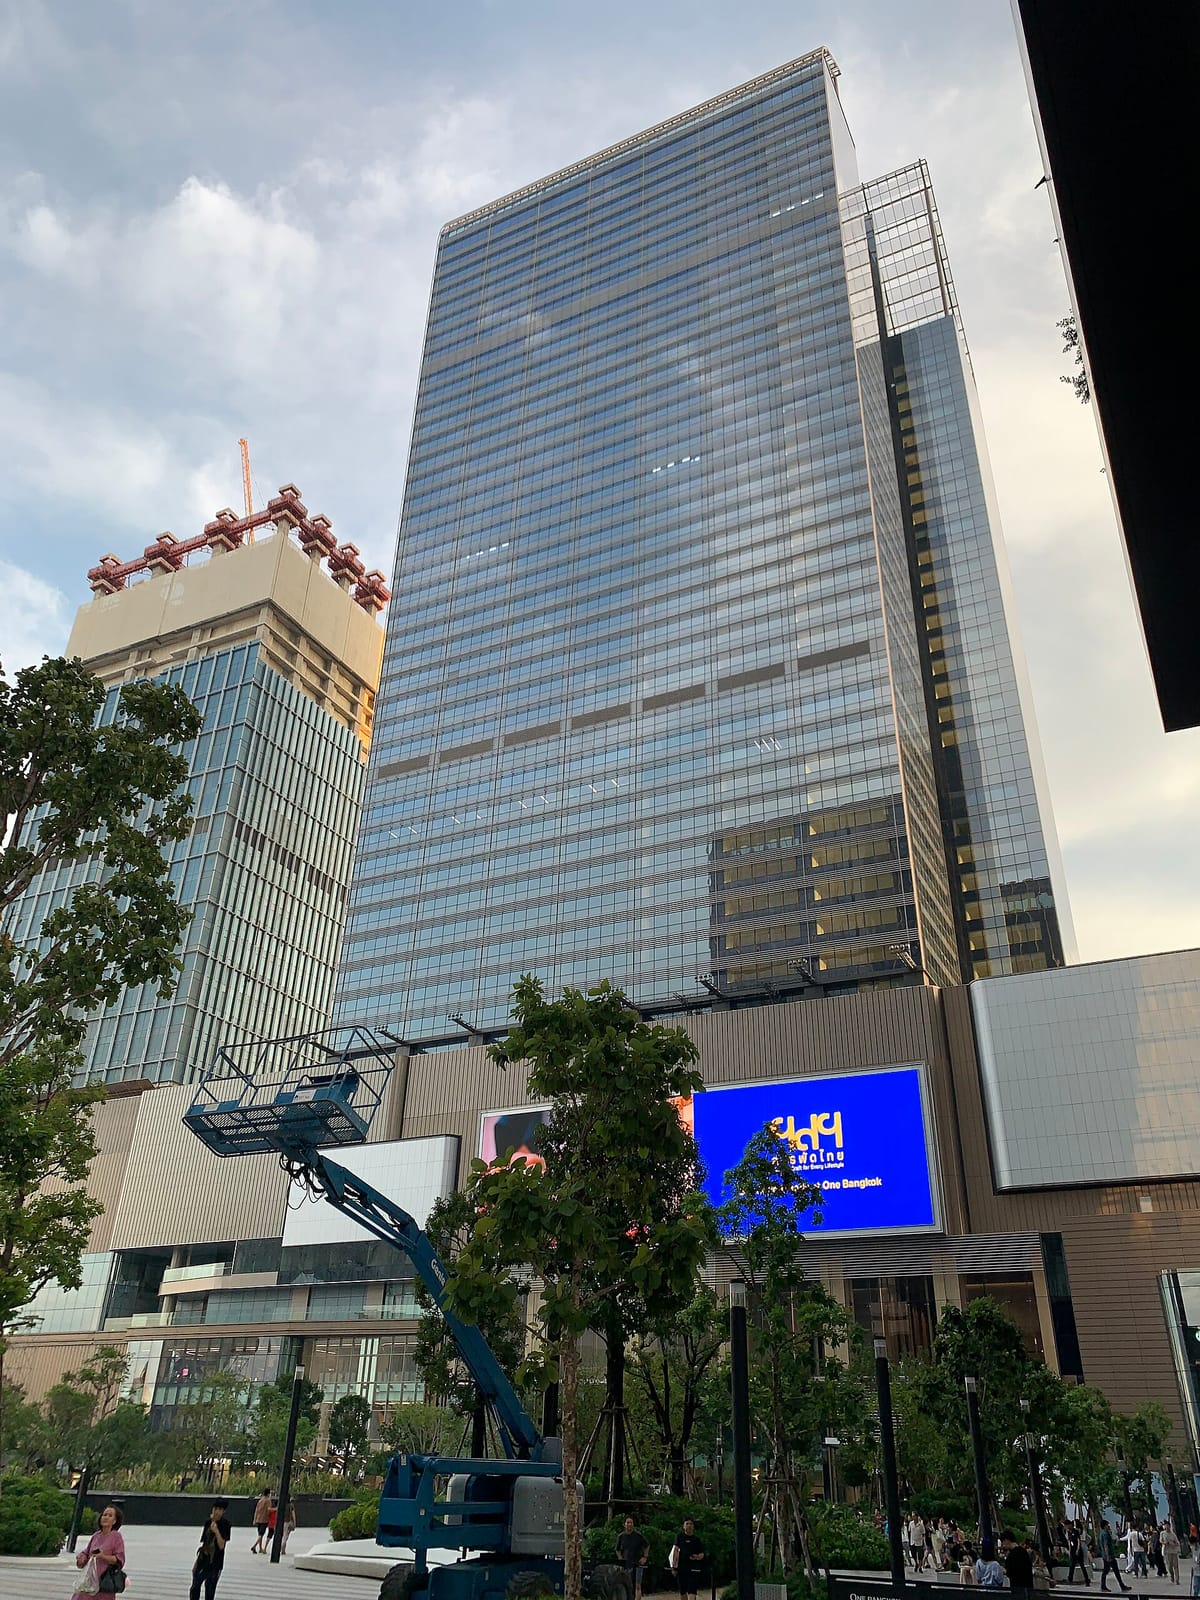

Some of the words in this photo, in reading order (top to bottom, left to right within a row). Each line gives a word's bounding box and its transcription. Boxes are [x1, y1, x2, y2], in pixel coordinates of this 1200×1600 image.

[822, 1180, 840, 1190] One
[842, 1176, 882, 1189] Bangkok
[431, 1259, 446, 1287] Genie
